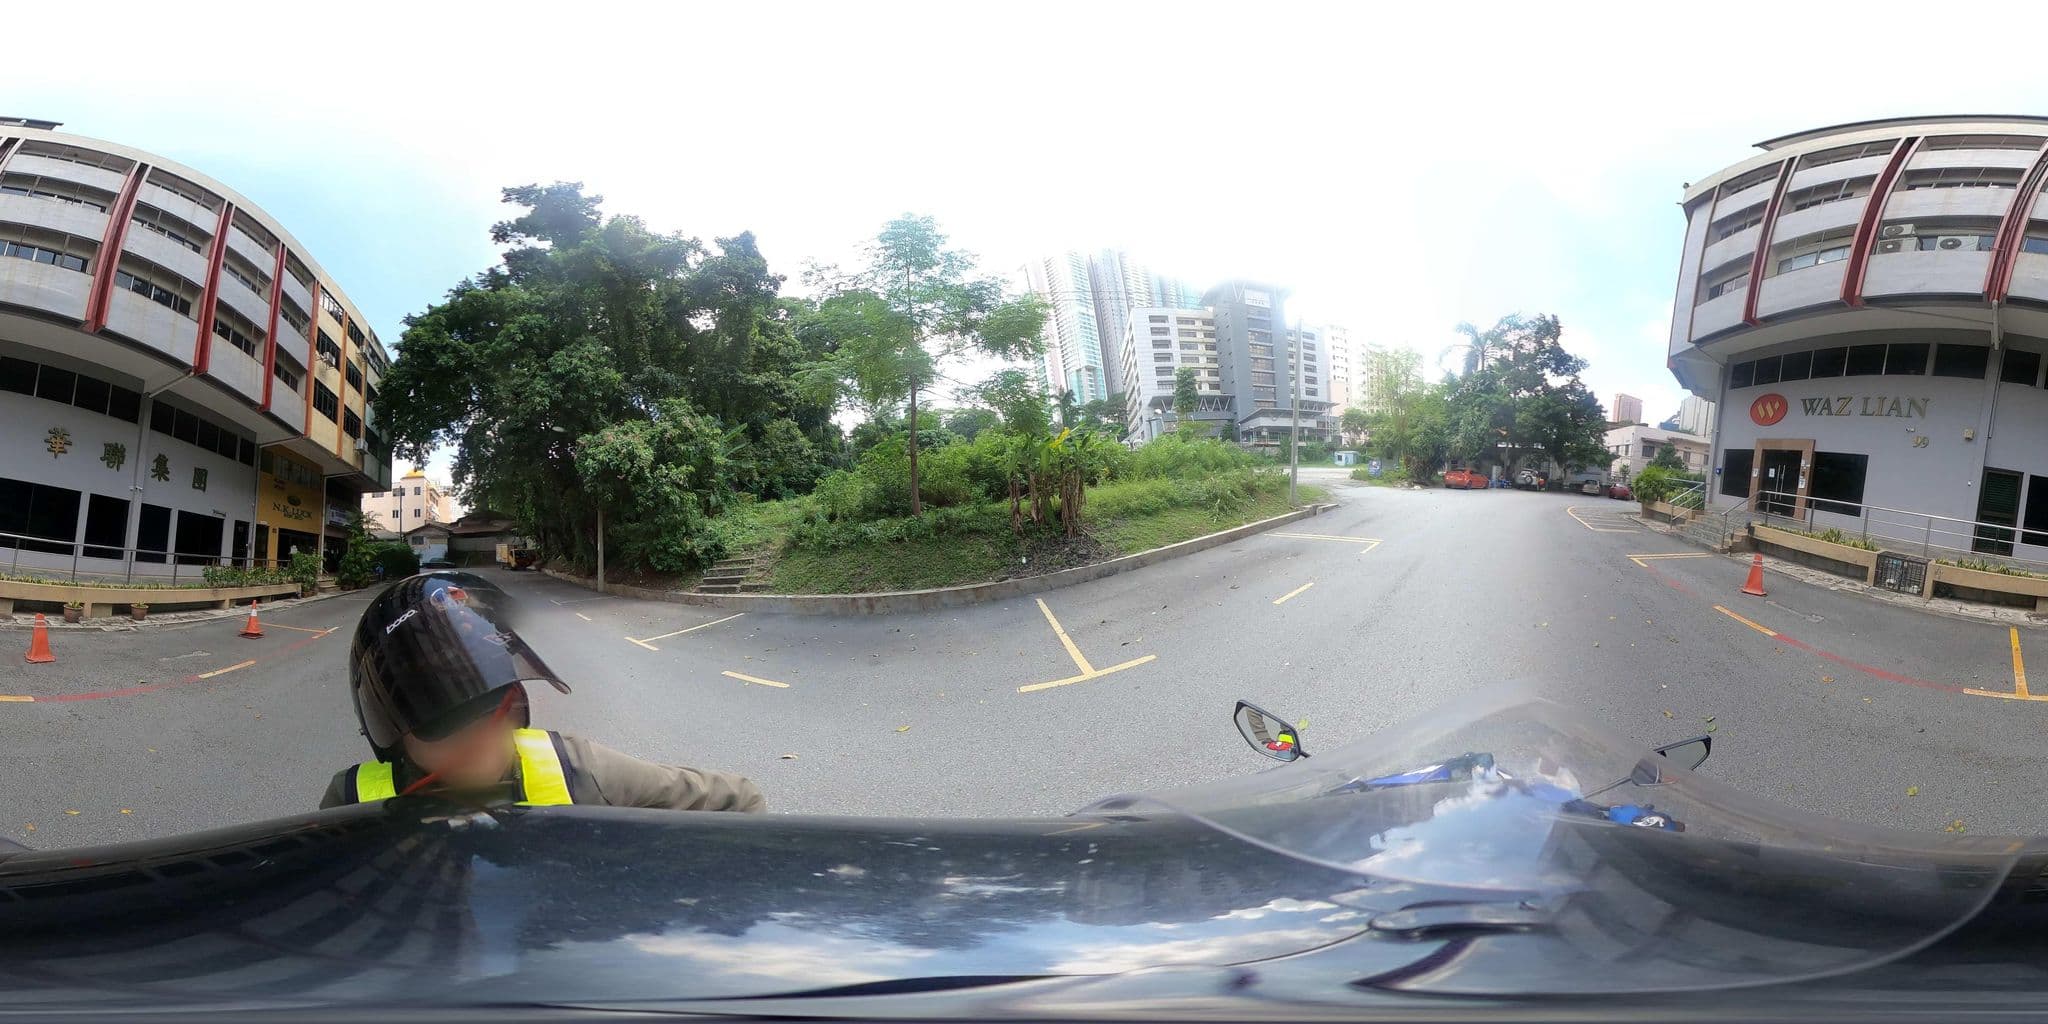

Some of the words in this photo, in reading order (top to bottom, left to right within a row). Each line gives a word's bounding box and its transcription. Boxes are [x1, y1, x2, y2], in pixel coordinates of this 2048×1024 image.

[1801, 396, 1854, 417] WAZ
[1860, 397, 1930, 419] LIAN
[44, 427, 208, 493] 華聯集團
